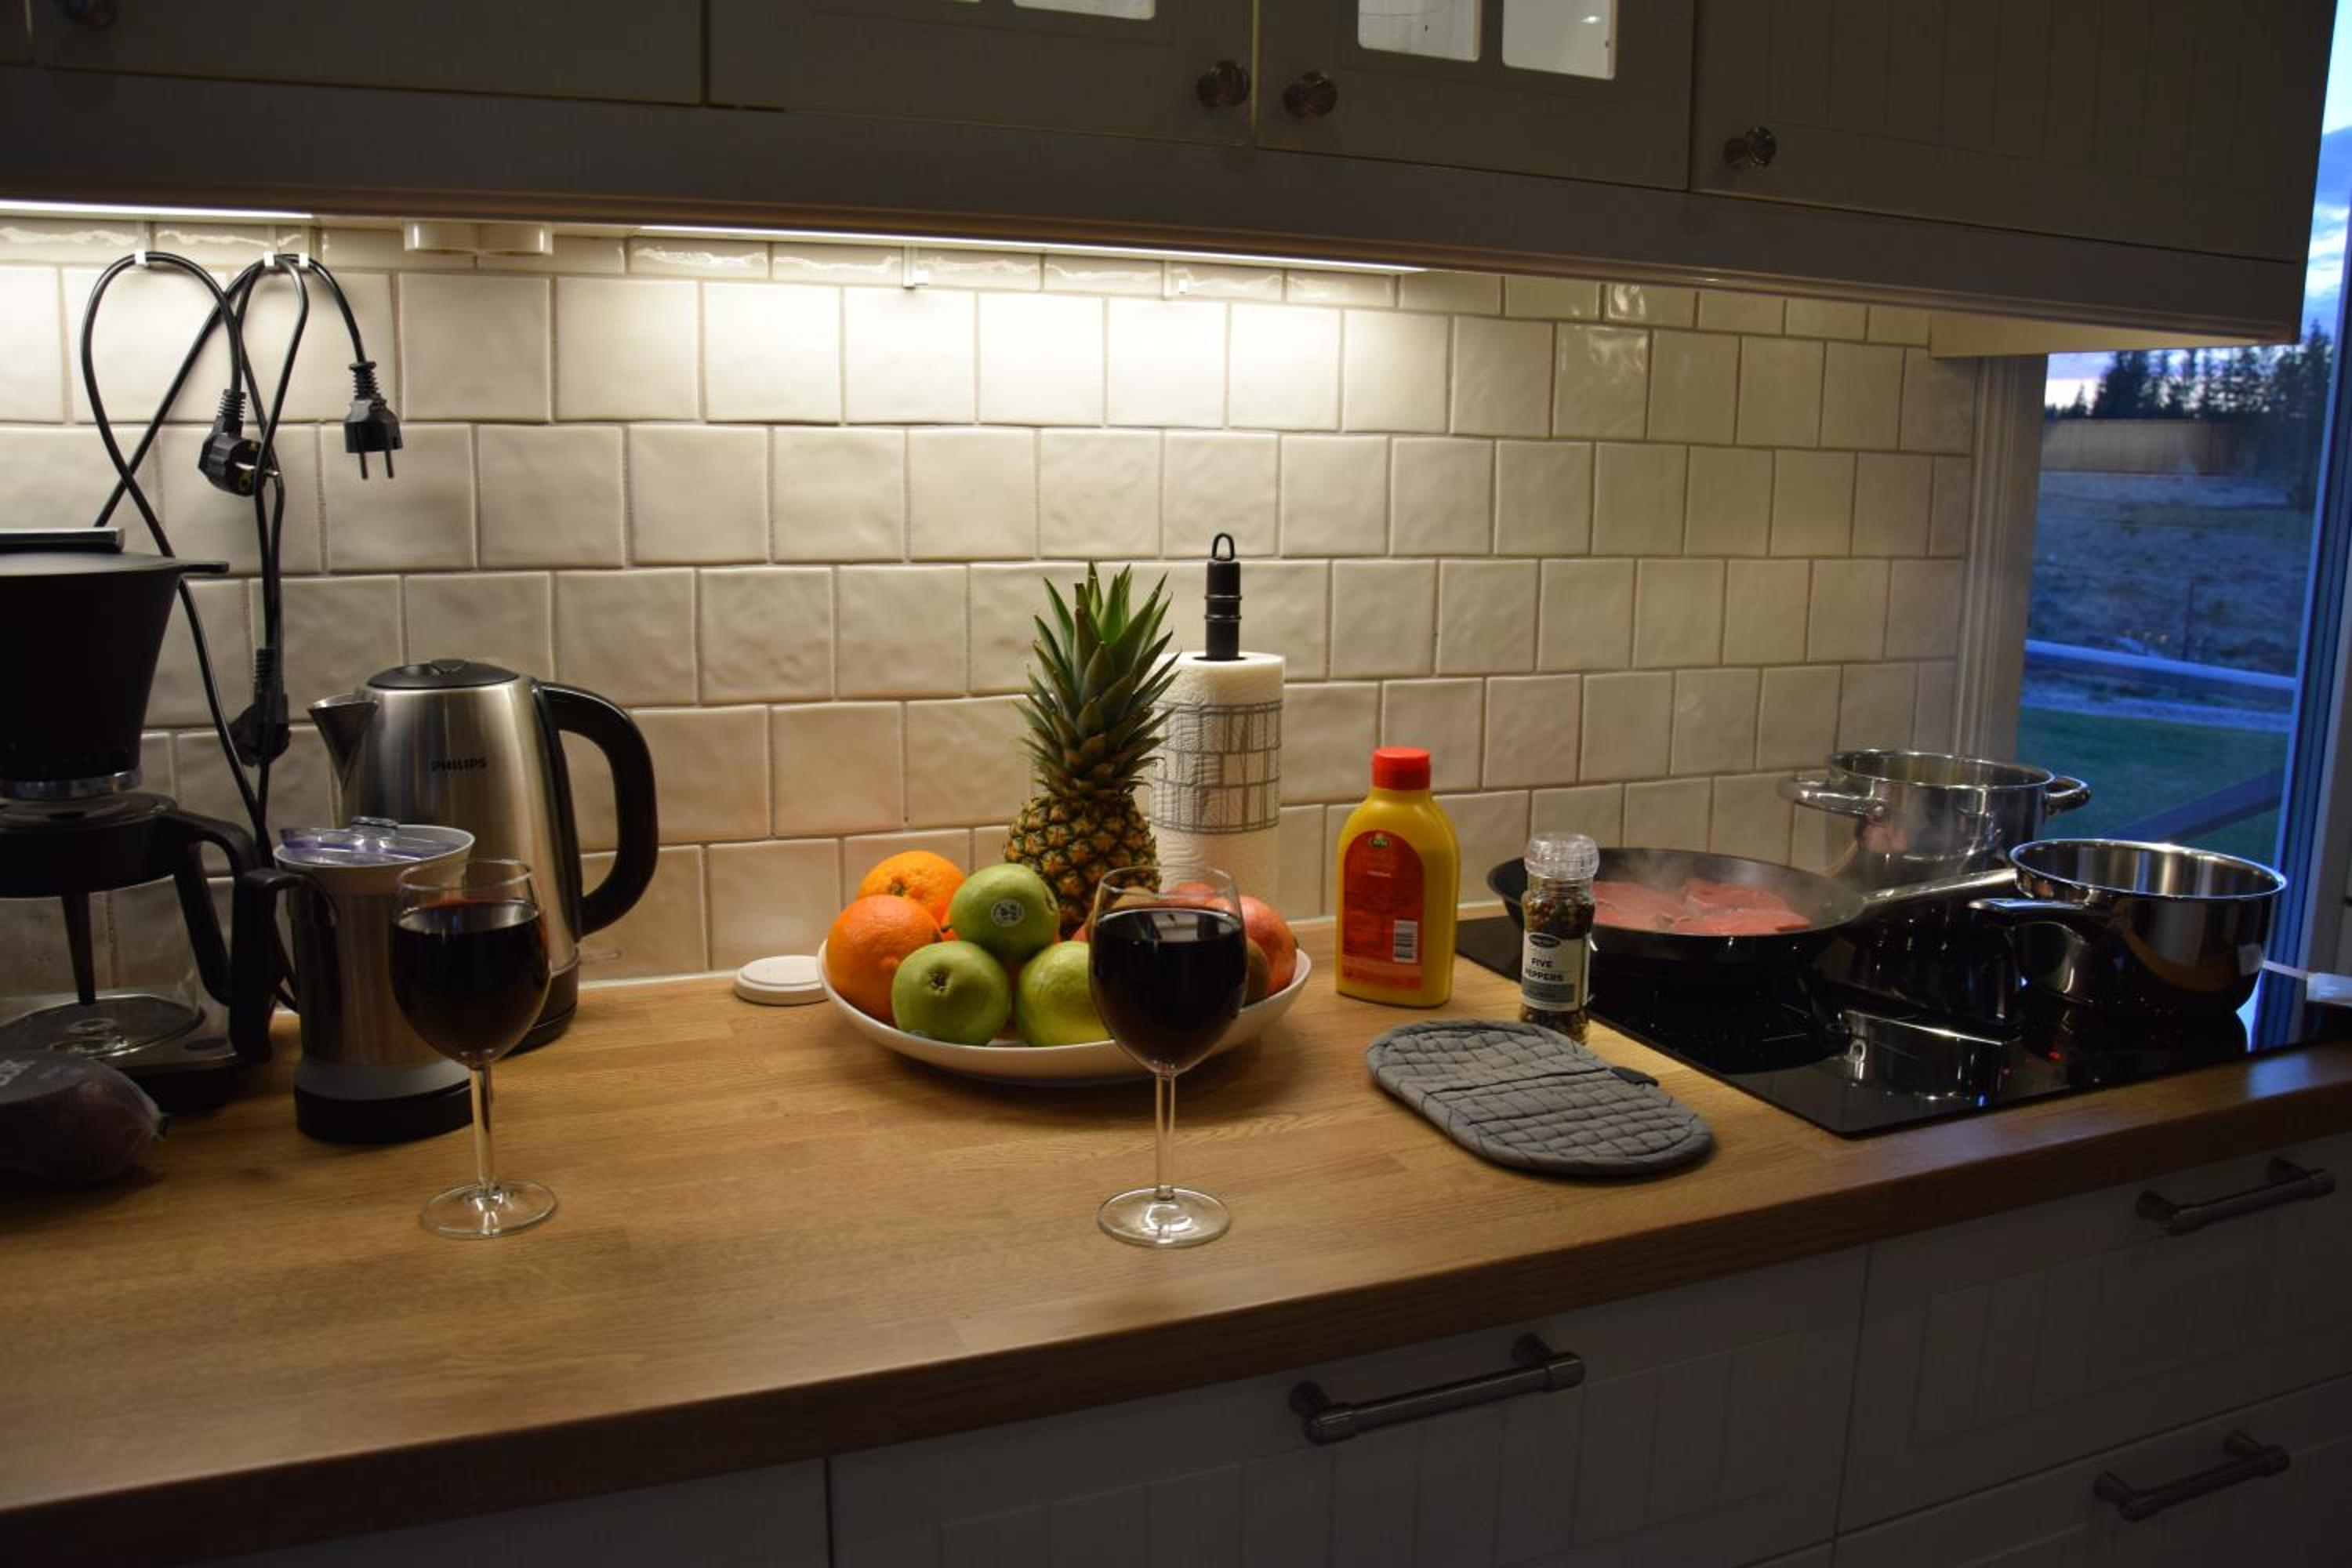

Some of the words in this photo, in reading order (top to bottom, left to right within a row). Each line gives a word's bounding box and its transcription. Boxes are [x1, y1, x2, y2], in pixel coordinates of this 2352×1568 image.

[431, 757, 487, 771] PHILIPS
[1532, 958, 1553, 967] FIVE
[1526, 967, 1564, 982] PEPPERS
